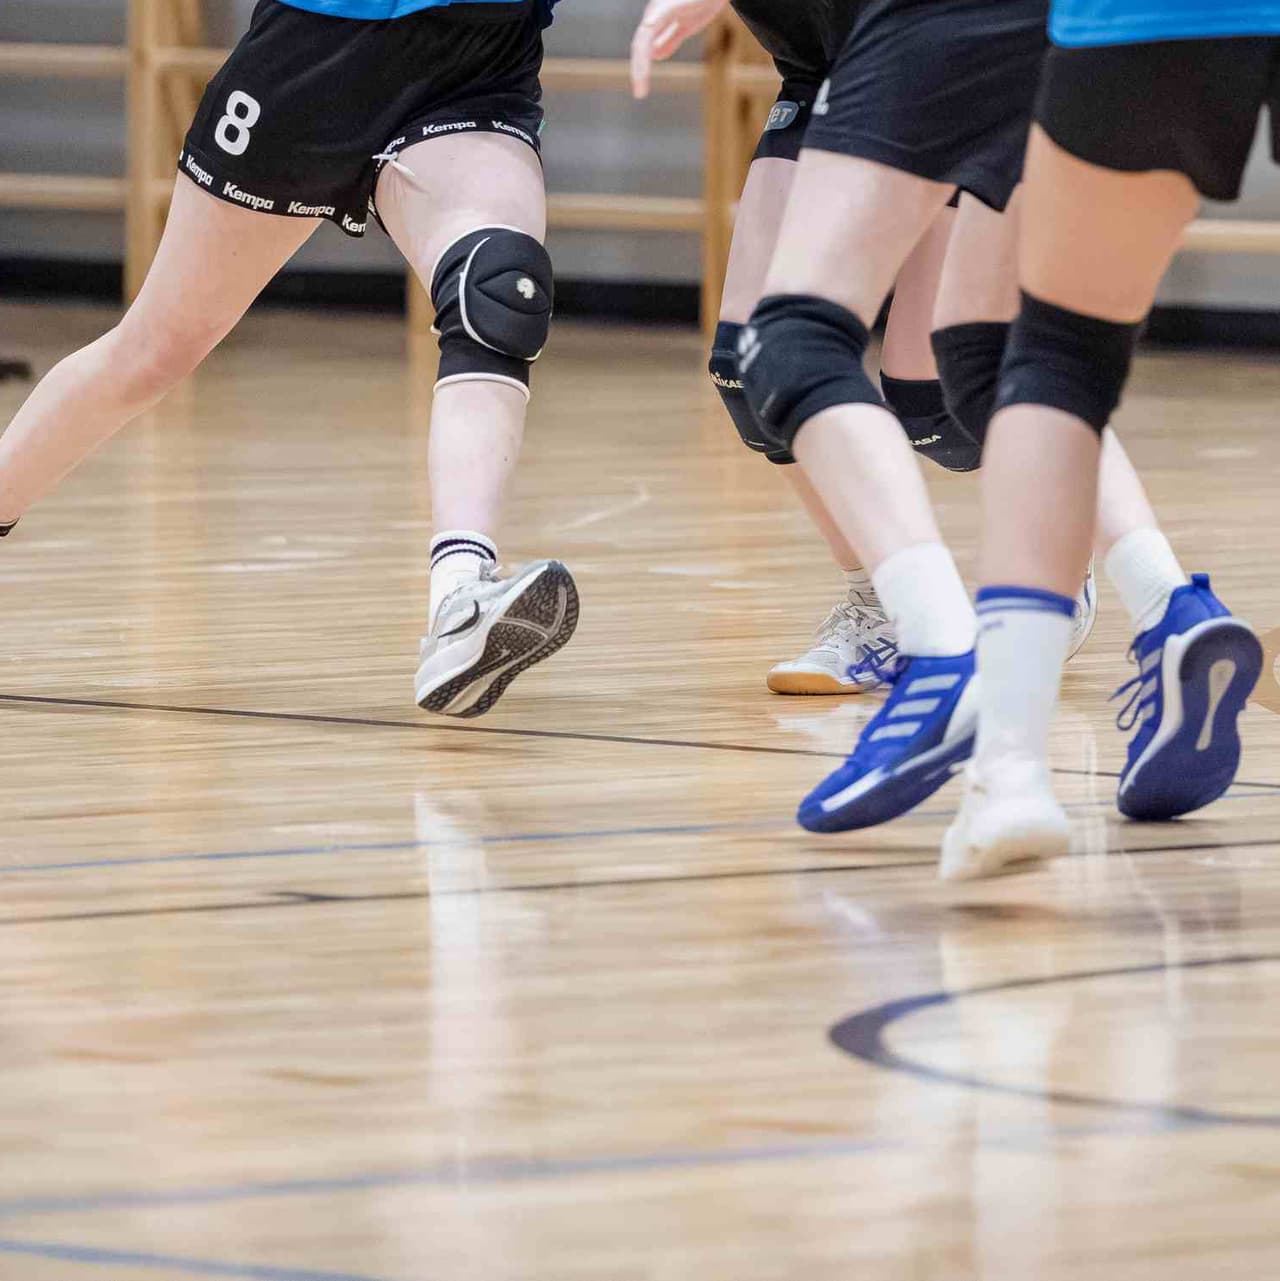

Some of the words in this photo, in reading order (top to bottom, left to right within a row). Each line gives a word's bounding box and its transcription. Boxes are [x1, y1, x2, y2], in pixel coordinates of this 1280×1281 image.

[214, 90, 261, 156] 8
[422, 121, 477, 137] Kempa
[186, 154, 214, 186] Kempa
[222, 181, 275, 210] Kempa
[287, 201, 336, 217] Kempa
